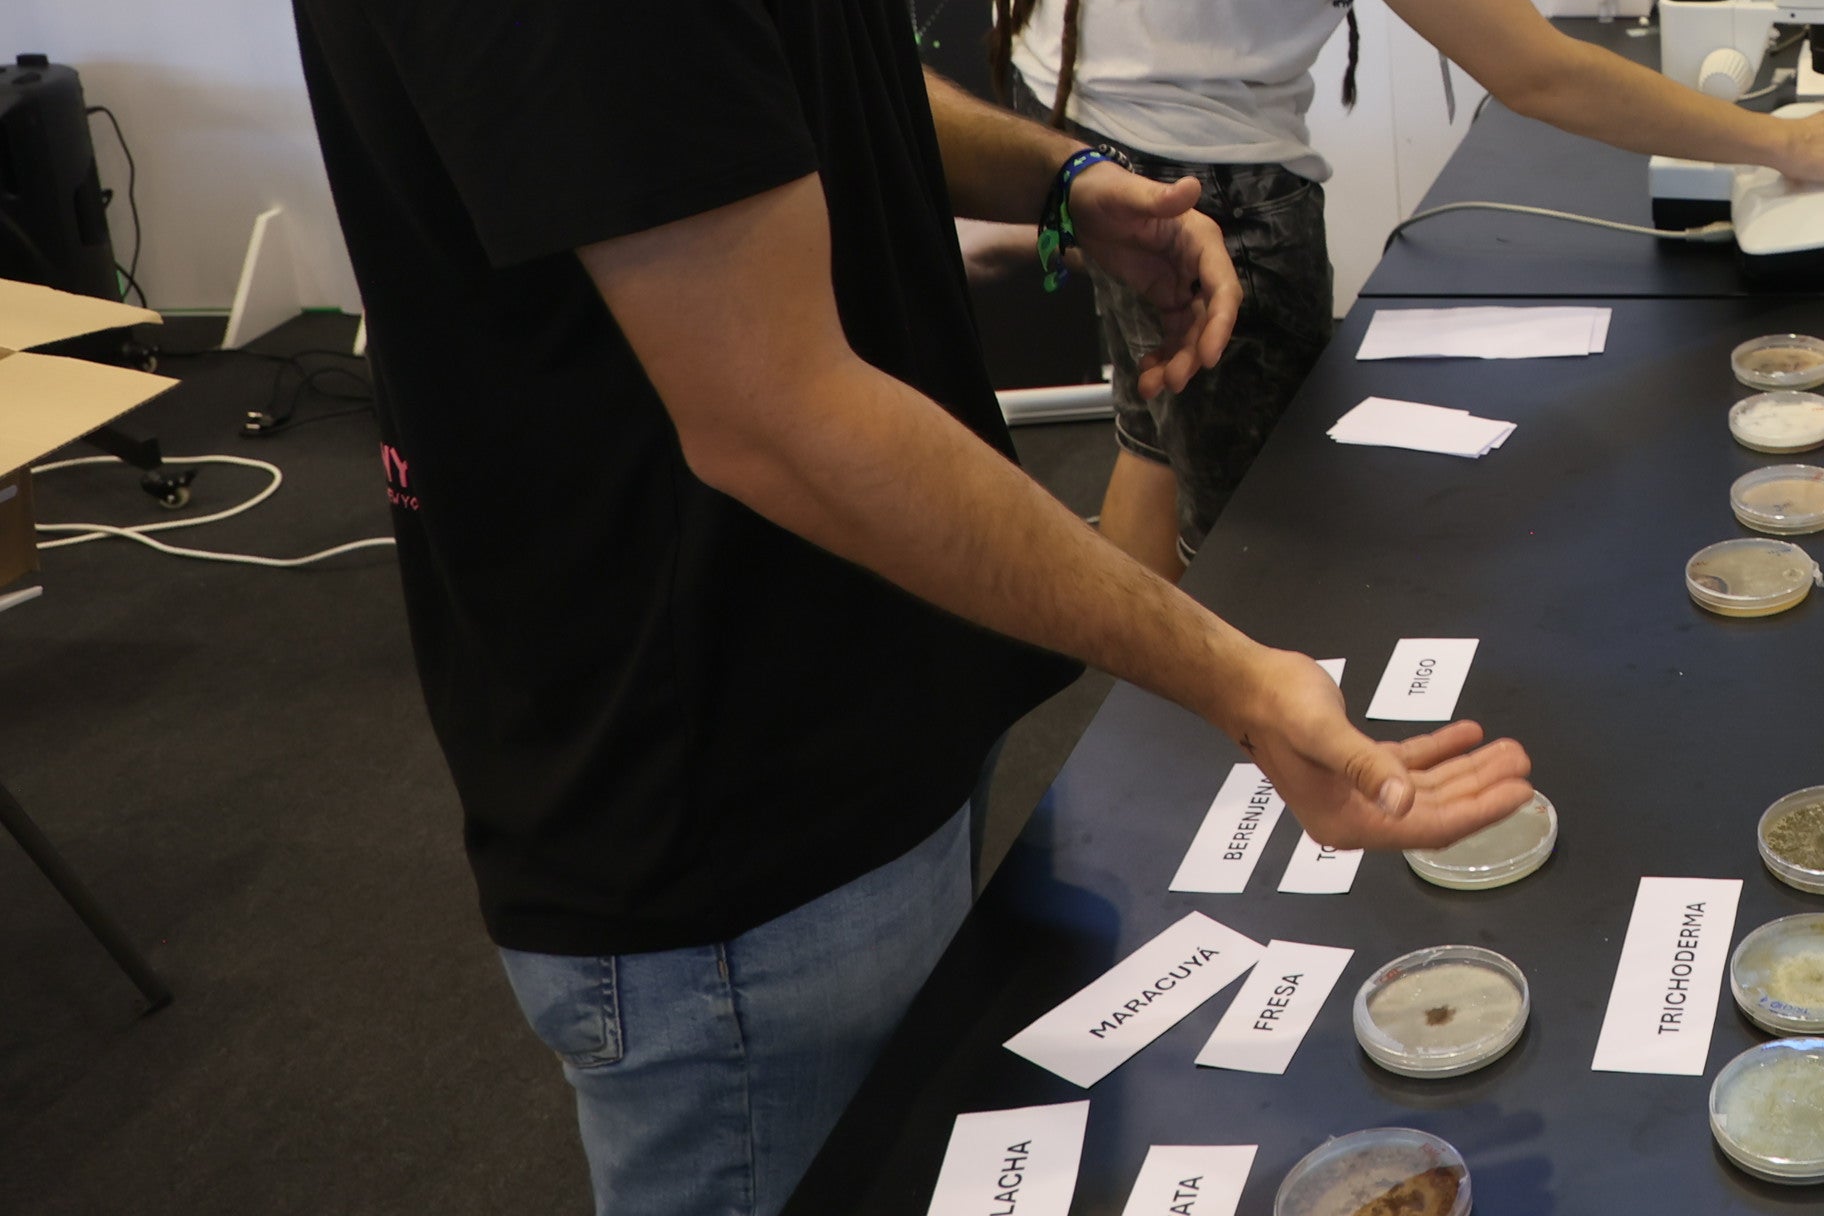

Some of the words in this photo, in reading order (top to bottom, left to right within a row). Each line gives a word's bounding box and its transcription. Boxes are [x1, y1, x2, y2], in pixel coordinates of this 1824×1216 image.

[1408, 658, 1437, 696] TRIGO
[1089, 946, 1220, 1039] MARACUYÁ
[1253, 972, 1304, 1031] FRESA
[1658, 902, 1706, 1035] TRICHODERMA
